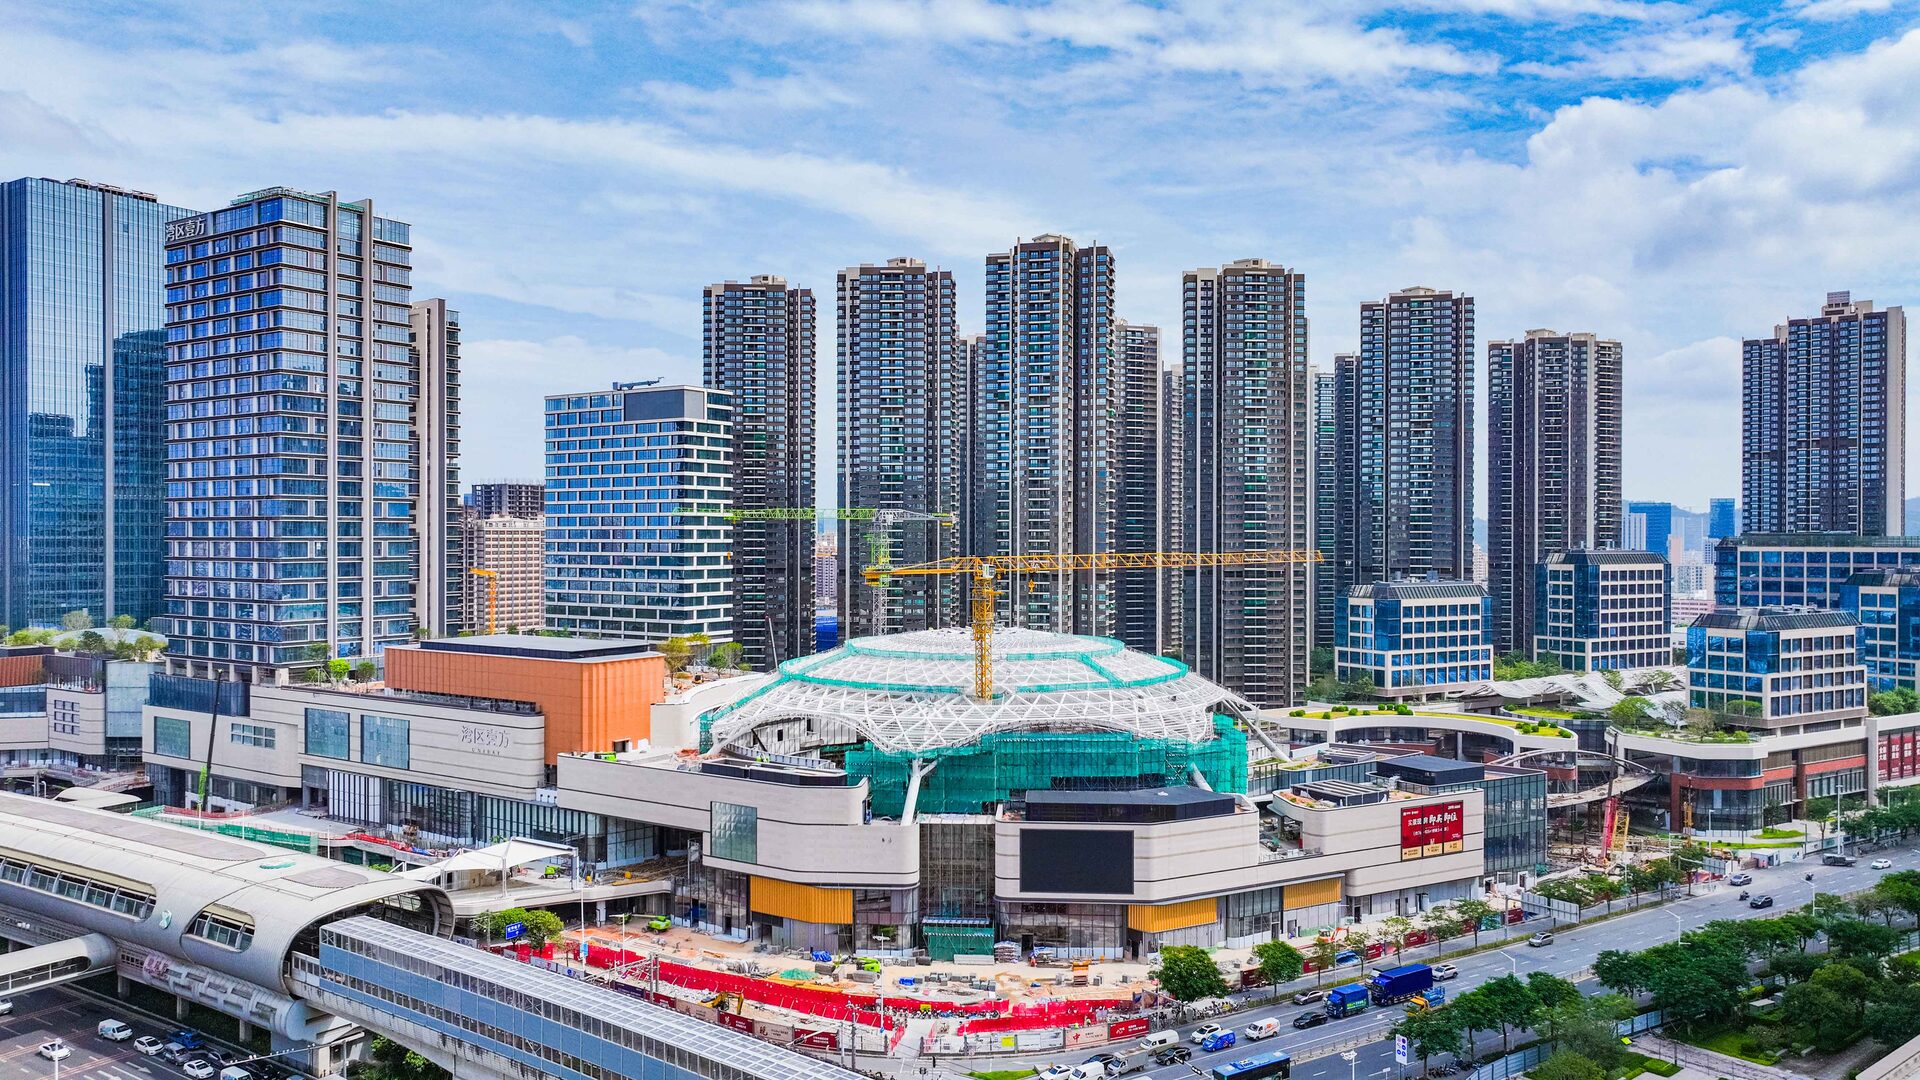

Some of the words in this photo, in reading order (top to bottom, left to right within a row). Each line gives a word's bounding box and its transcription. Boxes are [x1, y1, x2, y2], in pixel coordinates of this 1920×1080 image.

[165, 217, 206, 242] 湾区壹方
[461, 725, 511, 748] 湾区壹方
